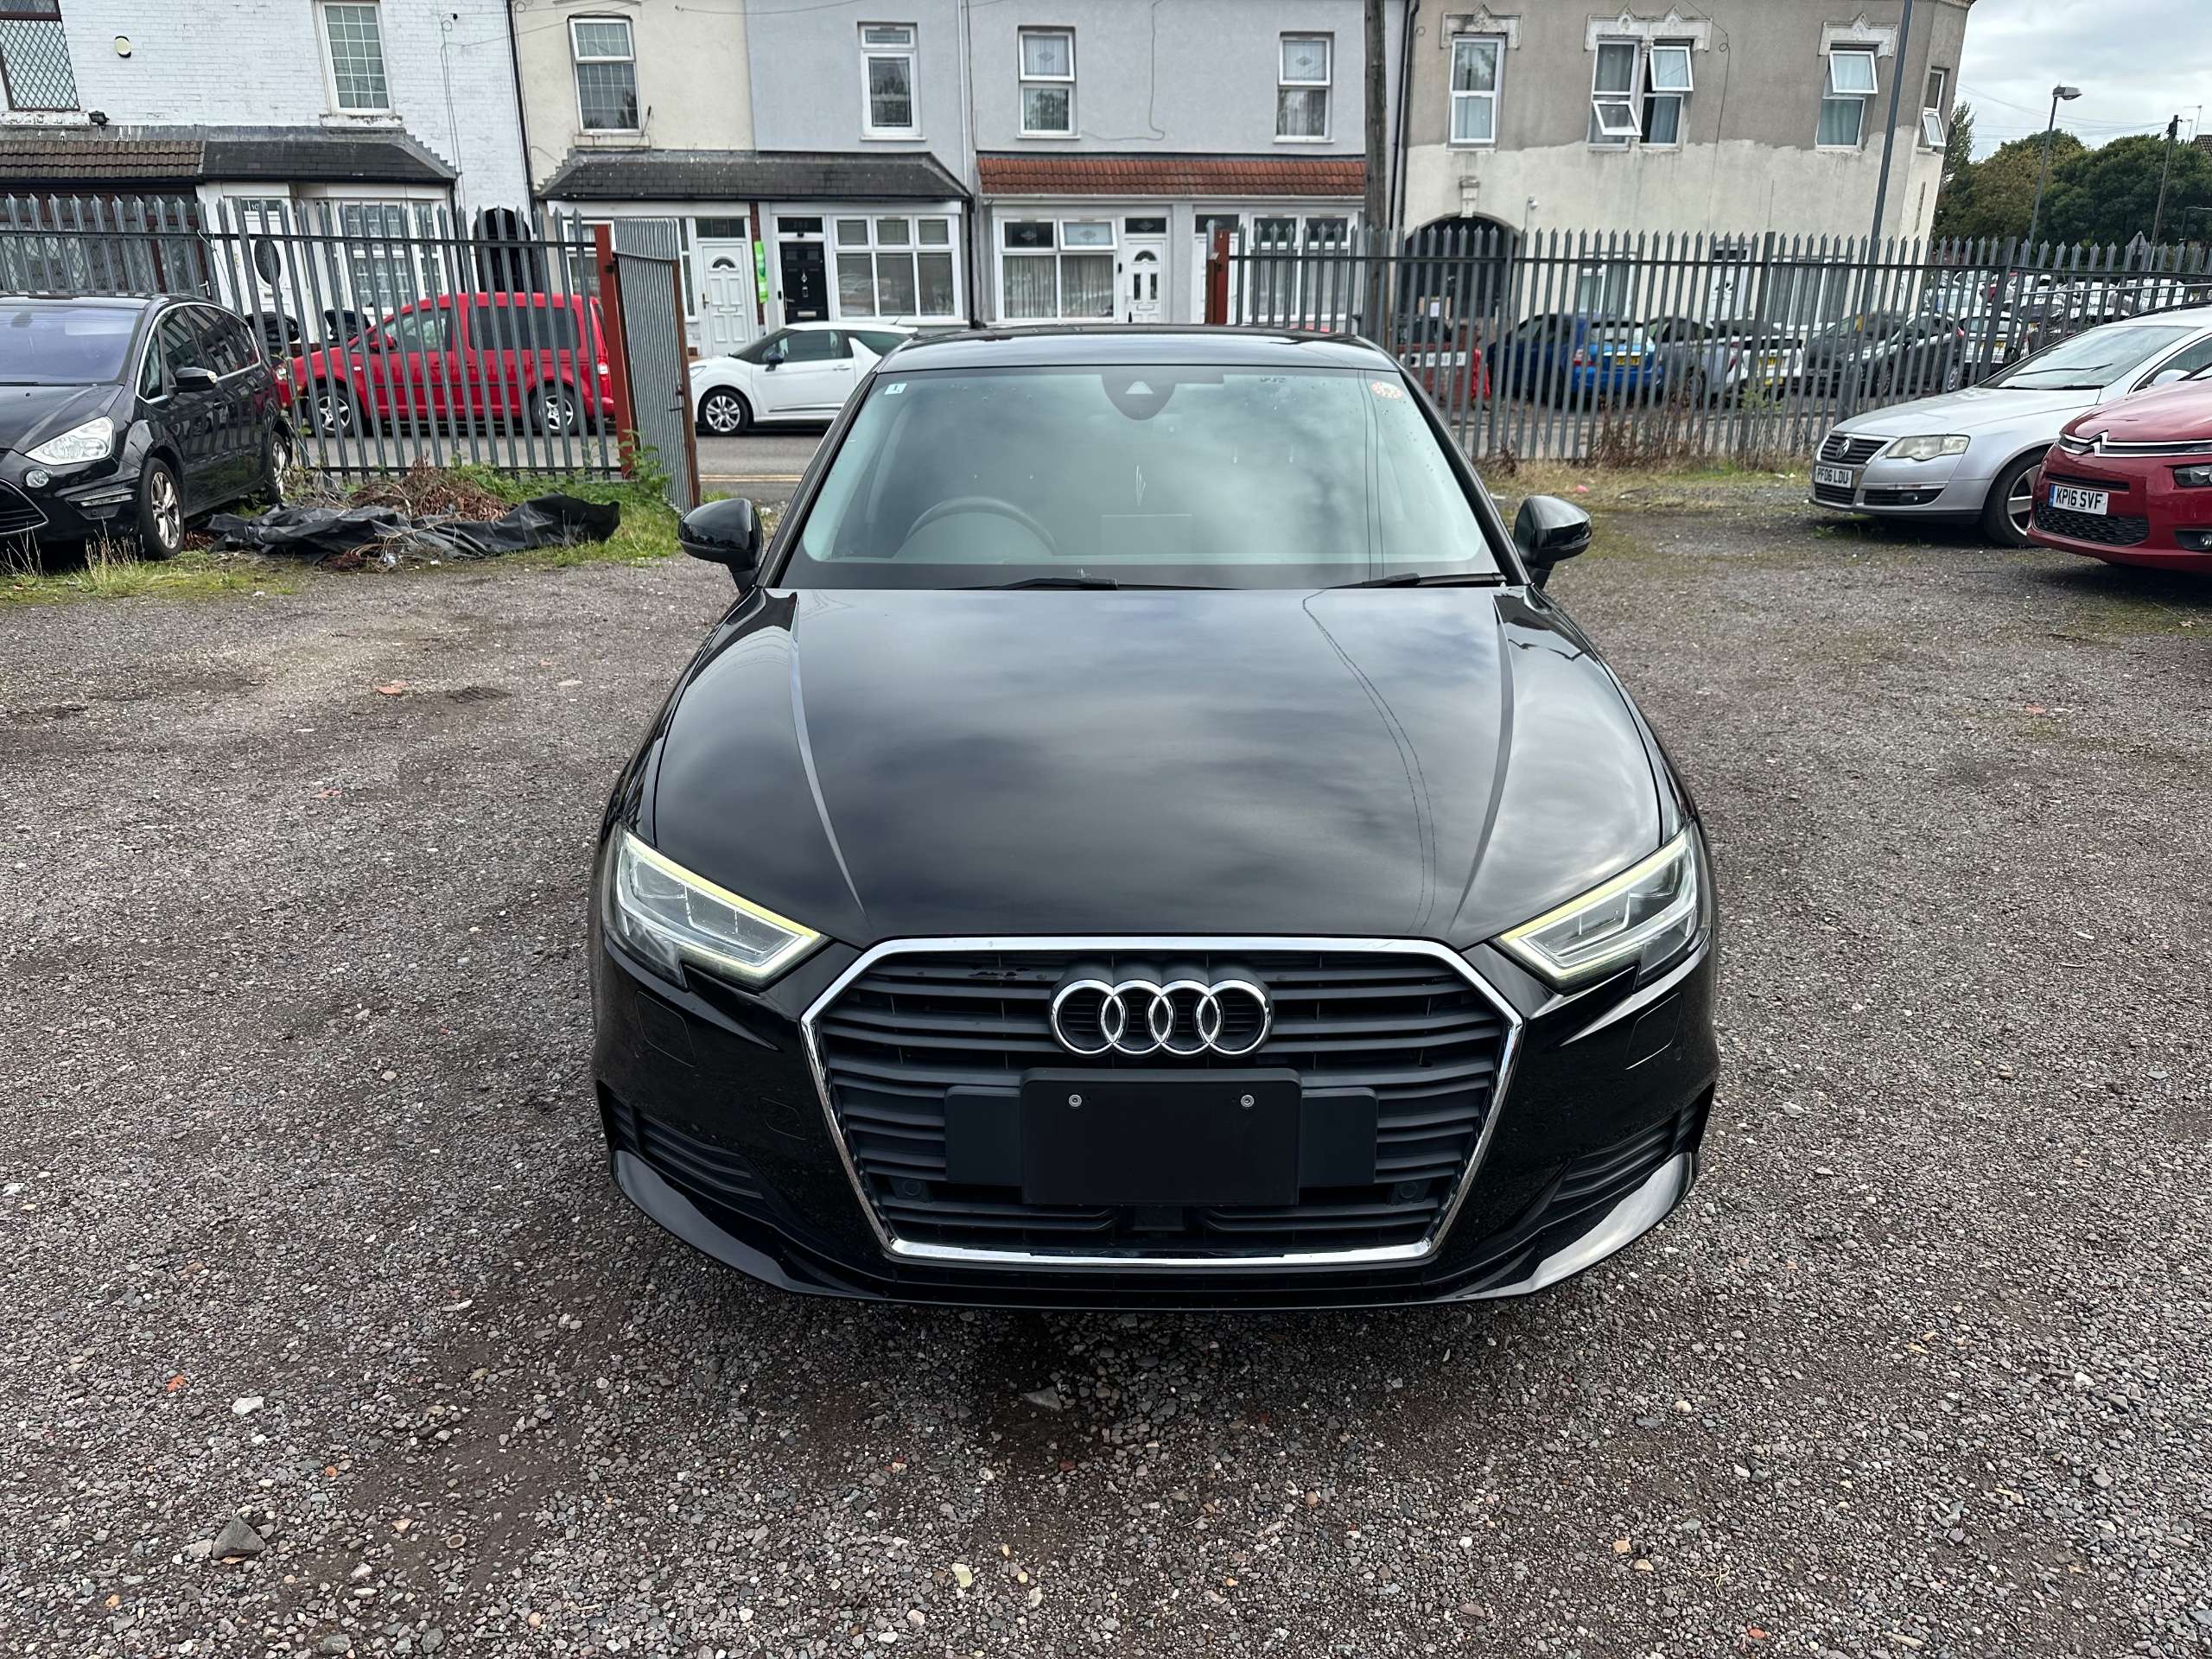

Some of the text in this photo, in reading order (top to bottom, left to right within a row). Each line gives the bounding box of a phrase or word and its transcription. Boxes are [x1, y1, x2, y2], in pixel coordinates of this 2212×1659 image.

[1817, 467, 1849, 484] PF06 LDU
[2056, 487, 2103, 510] KP16 SVF
